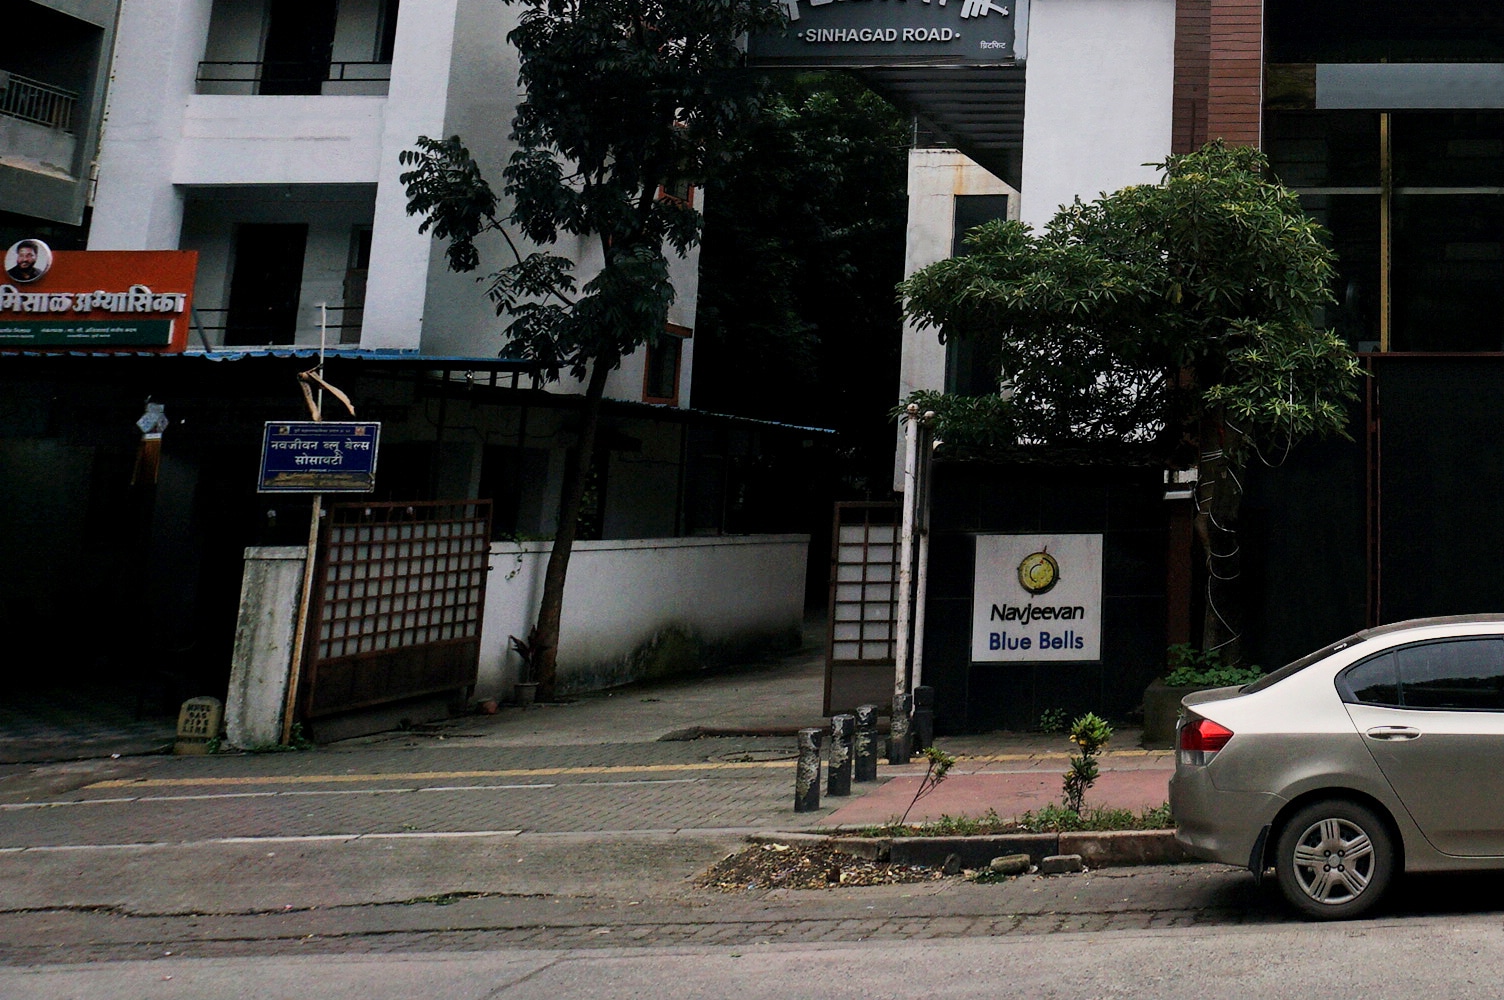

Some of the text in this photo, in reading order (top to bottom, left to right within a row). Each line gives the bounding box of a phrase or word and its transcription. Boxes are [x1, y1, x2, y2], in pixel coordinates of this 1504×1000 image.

[805, 28, 953, 43] SINHAGAD ROAD
[271, 438, 319, 450] नवजीवन
[990, 603, 1085, 626] Navjeevan
[989, 630, 1084, 651] Blue Bells
